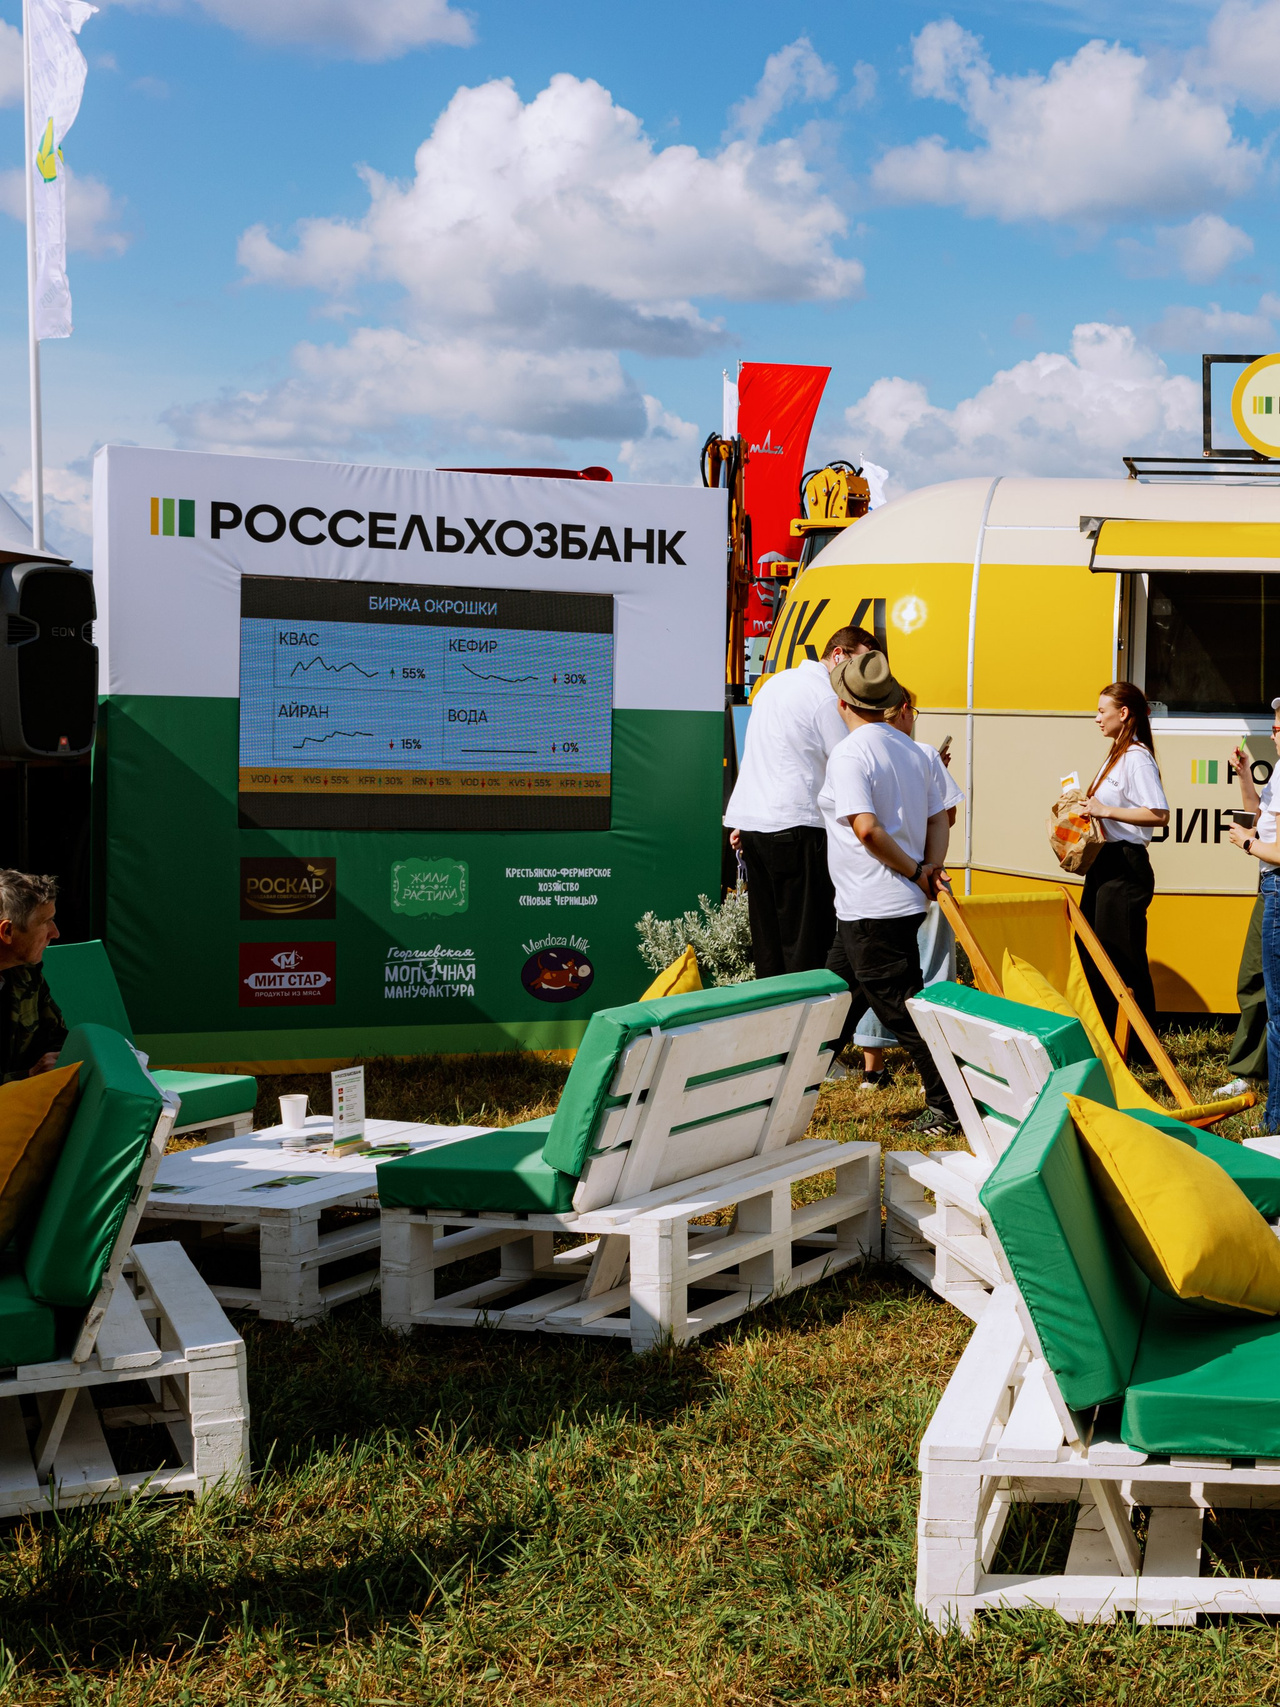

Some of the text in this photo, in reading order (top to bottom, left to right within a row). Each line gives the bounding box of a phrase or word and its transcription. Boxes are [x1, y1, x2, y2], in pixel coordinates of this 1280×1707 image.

[210, 500, 688, 566] РОССЕЛЬХОЗБАНК
[369, 596, 498, 615] БИРЖА ОКРОШКИ
[51, 626, 76, 637] EON
[279, 632, 320, 646] КВАС
[449, 639, 498, 653] КЕФИР
[402, 668, 426, 679] 55%
[563, 674, 587, 685] 30%
[278, 701, 329, 718] АЙРАН
[448, 709, 488, 725] ВОДА
[401, 739, 422, 750] 15%
[562, 742, 580, 753] 0%
[251, 775, 271, 784] VOD
[303, 776, 322, 784] KVS
[358, 776, 375, 785] KFR
[461, 778, 479, 786] VOD
[509, 778, 525, 787] KVS
[560, 779, 576, 787] KFR
[410, 872, 450, 884] ЖИЛИ
[246, 877, 324, 894] РОСКАР
[402, 888, 458, 901] РАСТИЛИ
[521, 933, 591, 955] Mendoza Milk
[386, 944, 475, 962] Георгиевская
[254, 974, 322, 987] МИТ СТАР
[384, 984, 475, 998] МАНУФАКТУРА
